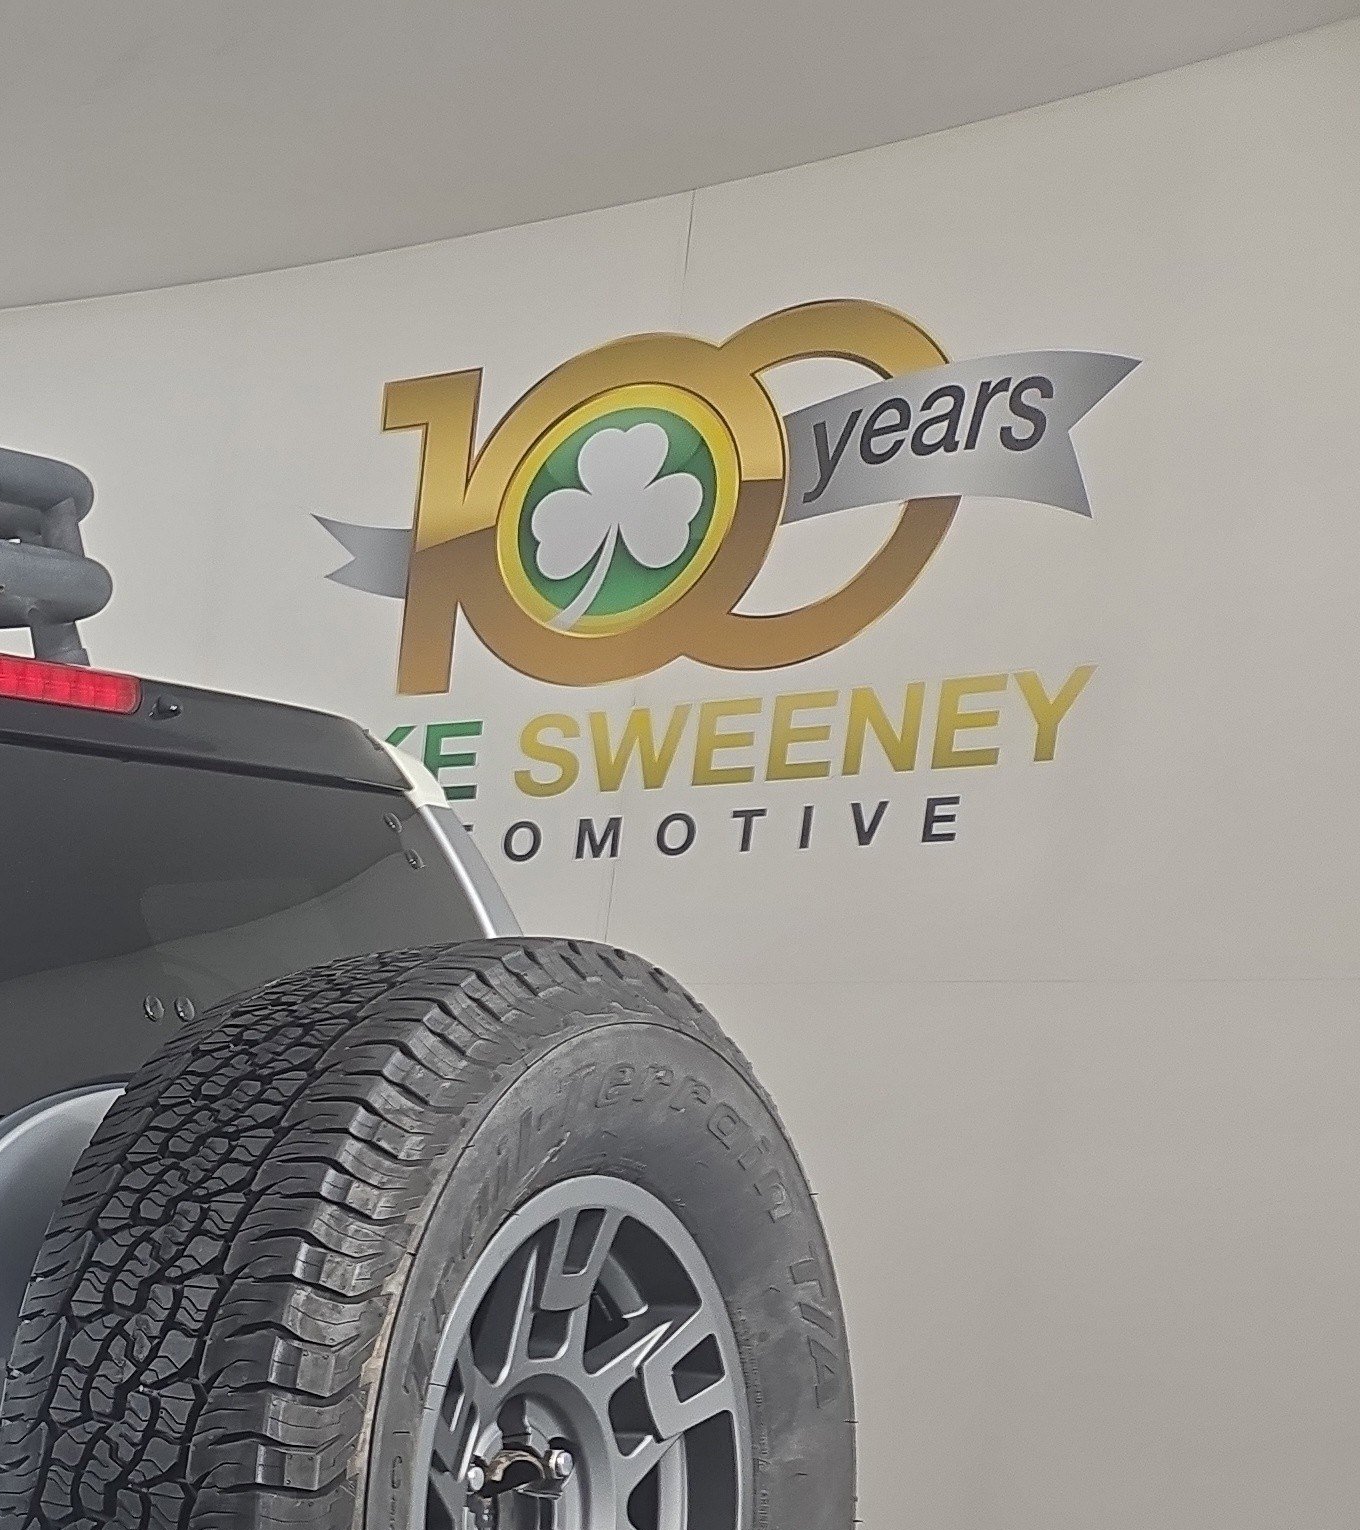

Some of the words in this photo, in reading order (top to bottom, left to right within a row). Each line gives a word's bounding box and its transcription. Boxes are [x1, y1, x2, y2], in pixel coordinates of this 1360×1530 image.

[802, 375, 1054, 503] years
[514, 664, 1096, 797] SWEENEY
[462, 795, 962, 863] OMOTIVE
